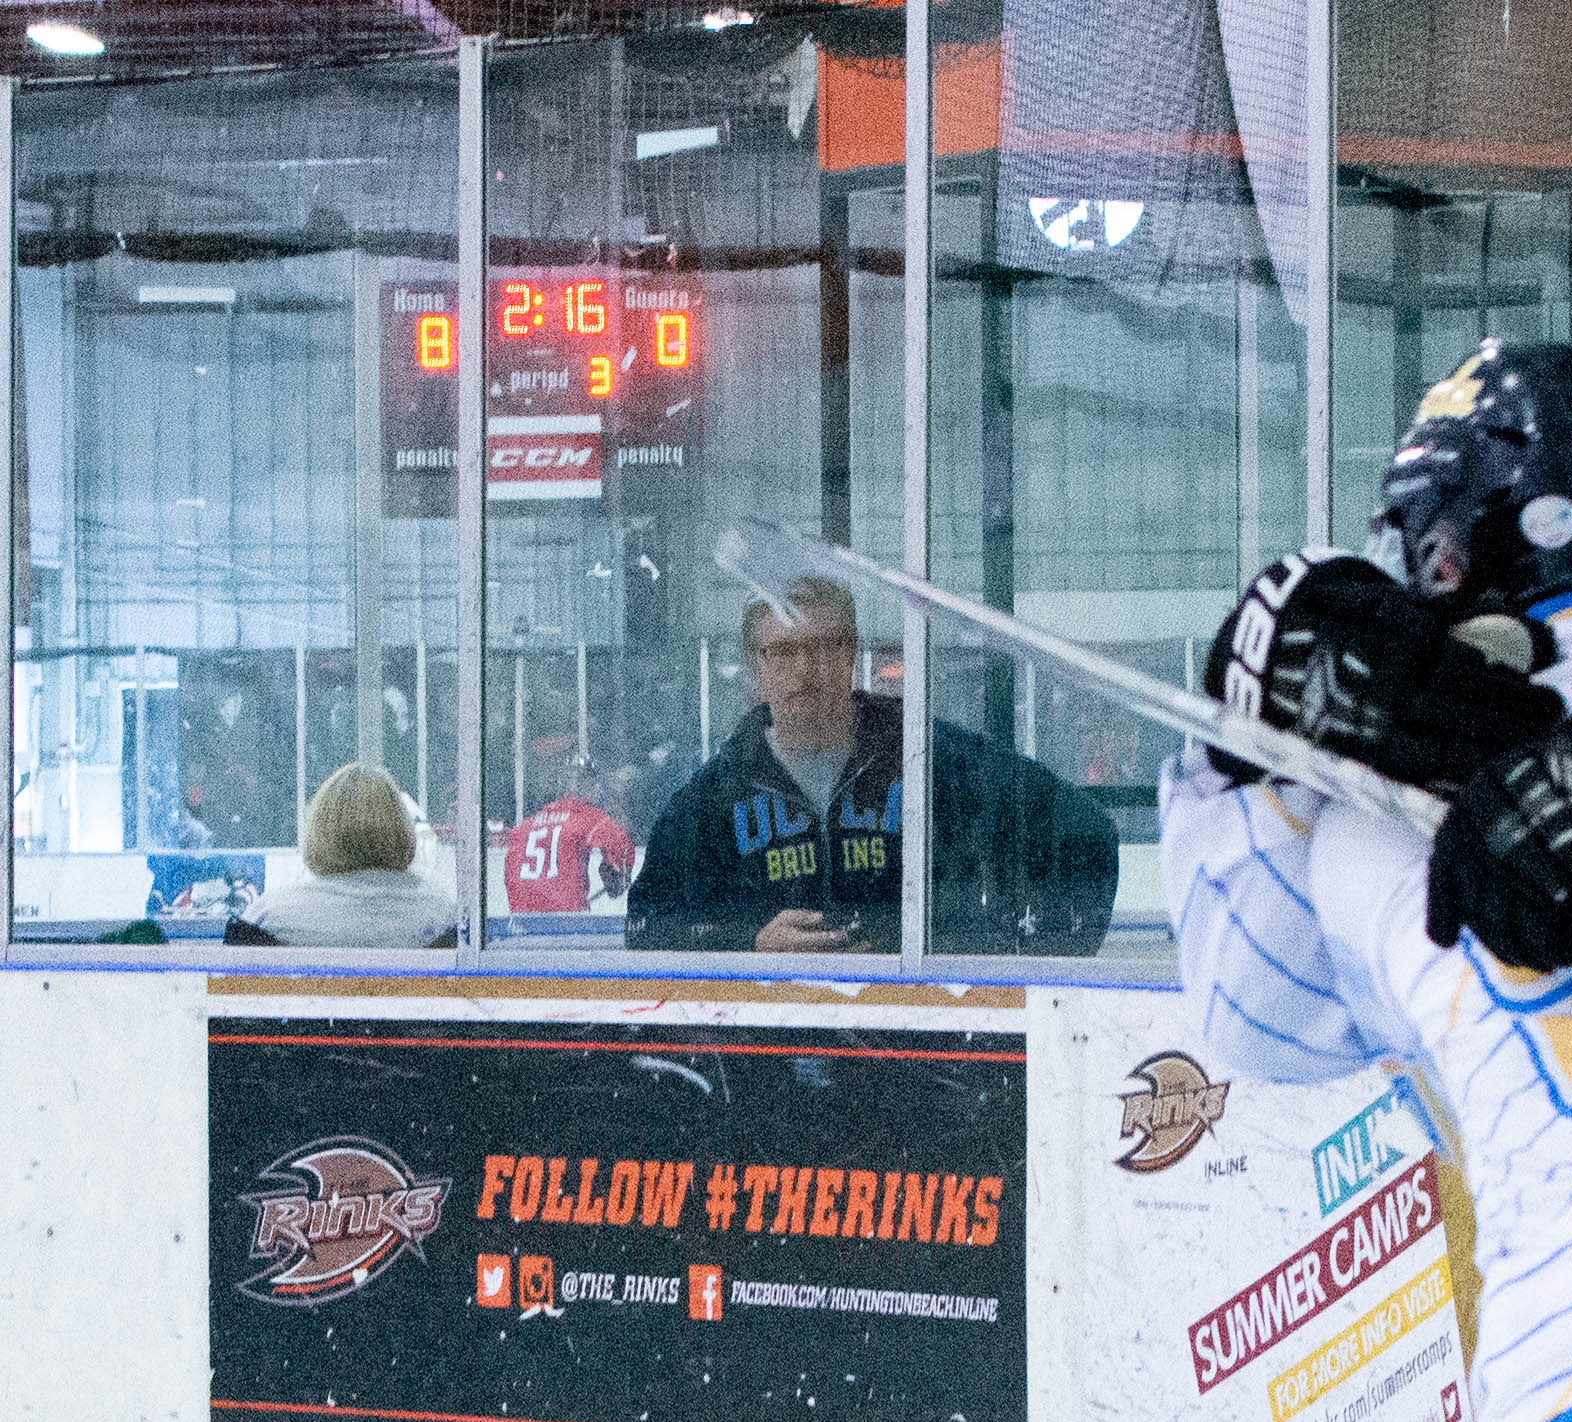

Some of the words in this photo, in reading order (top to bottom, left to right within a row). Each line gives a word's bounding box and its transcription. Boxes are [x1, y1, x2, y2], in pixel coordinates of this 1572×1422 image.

[394, 289, 446, 313] Home
[503, 283, 606, 335] 2:16
[419, 315, 451, 369] 8
[656, 313, 688, 367] 0
[510, 368, 570, 394] period
[589, 356, 613, 396] 3
[490, 447, 593, 468] CCM
[617, 443, 684, 469] penalty
[519, 824, 562, 880] 51
[1203, 1156, 1249, 1178] INLINE
[477, 1154, 694, 1227] FOLLOW
[705, 1163, 1002, 1247] #THERINKS
[560, 1271, 681, 1305] @THE_RINKS
[1194, 1251, 1327, 1383] SUMMER
[1328, 1167, 1433, 1288] CAMPS
[1274, 1366, 1311, 1418] FOR
[1311, 1333, 1360, 1393] MORE
[1360, 1301, 1402, 1355] INFO
